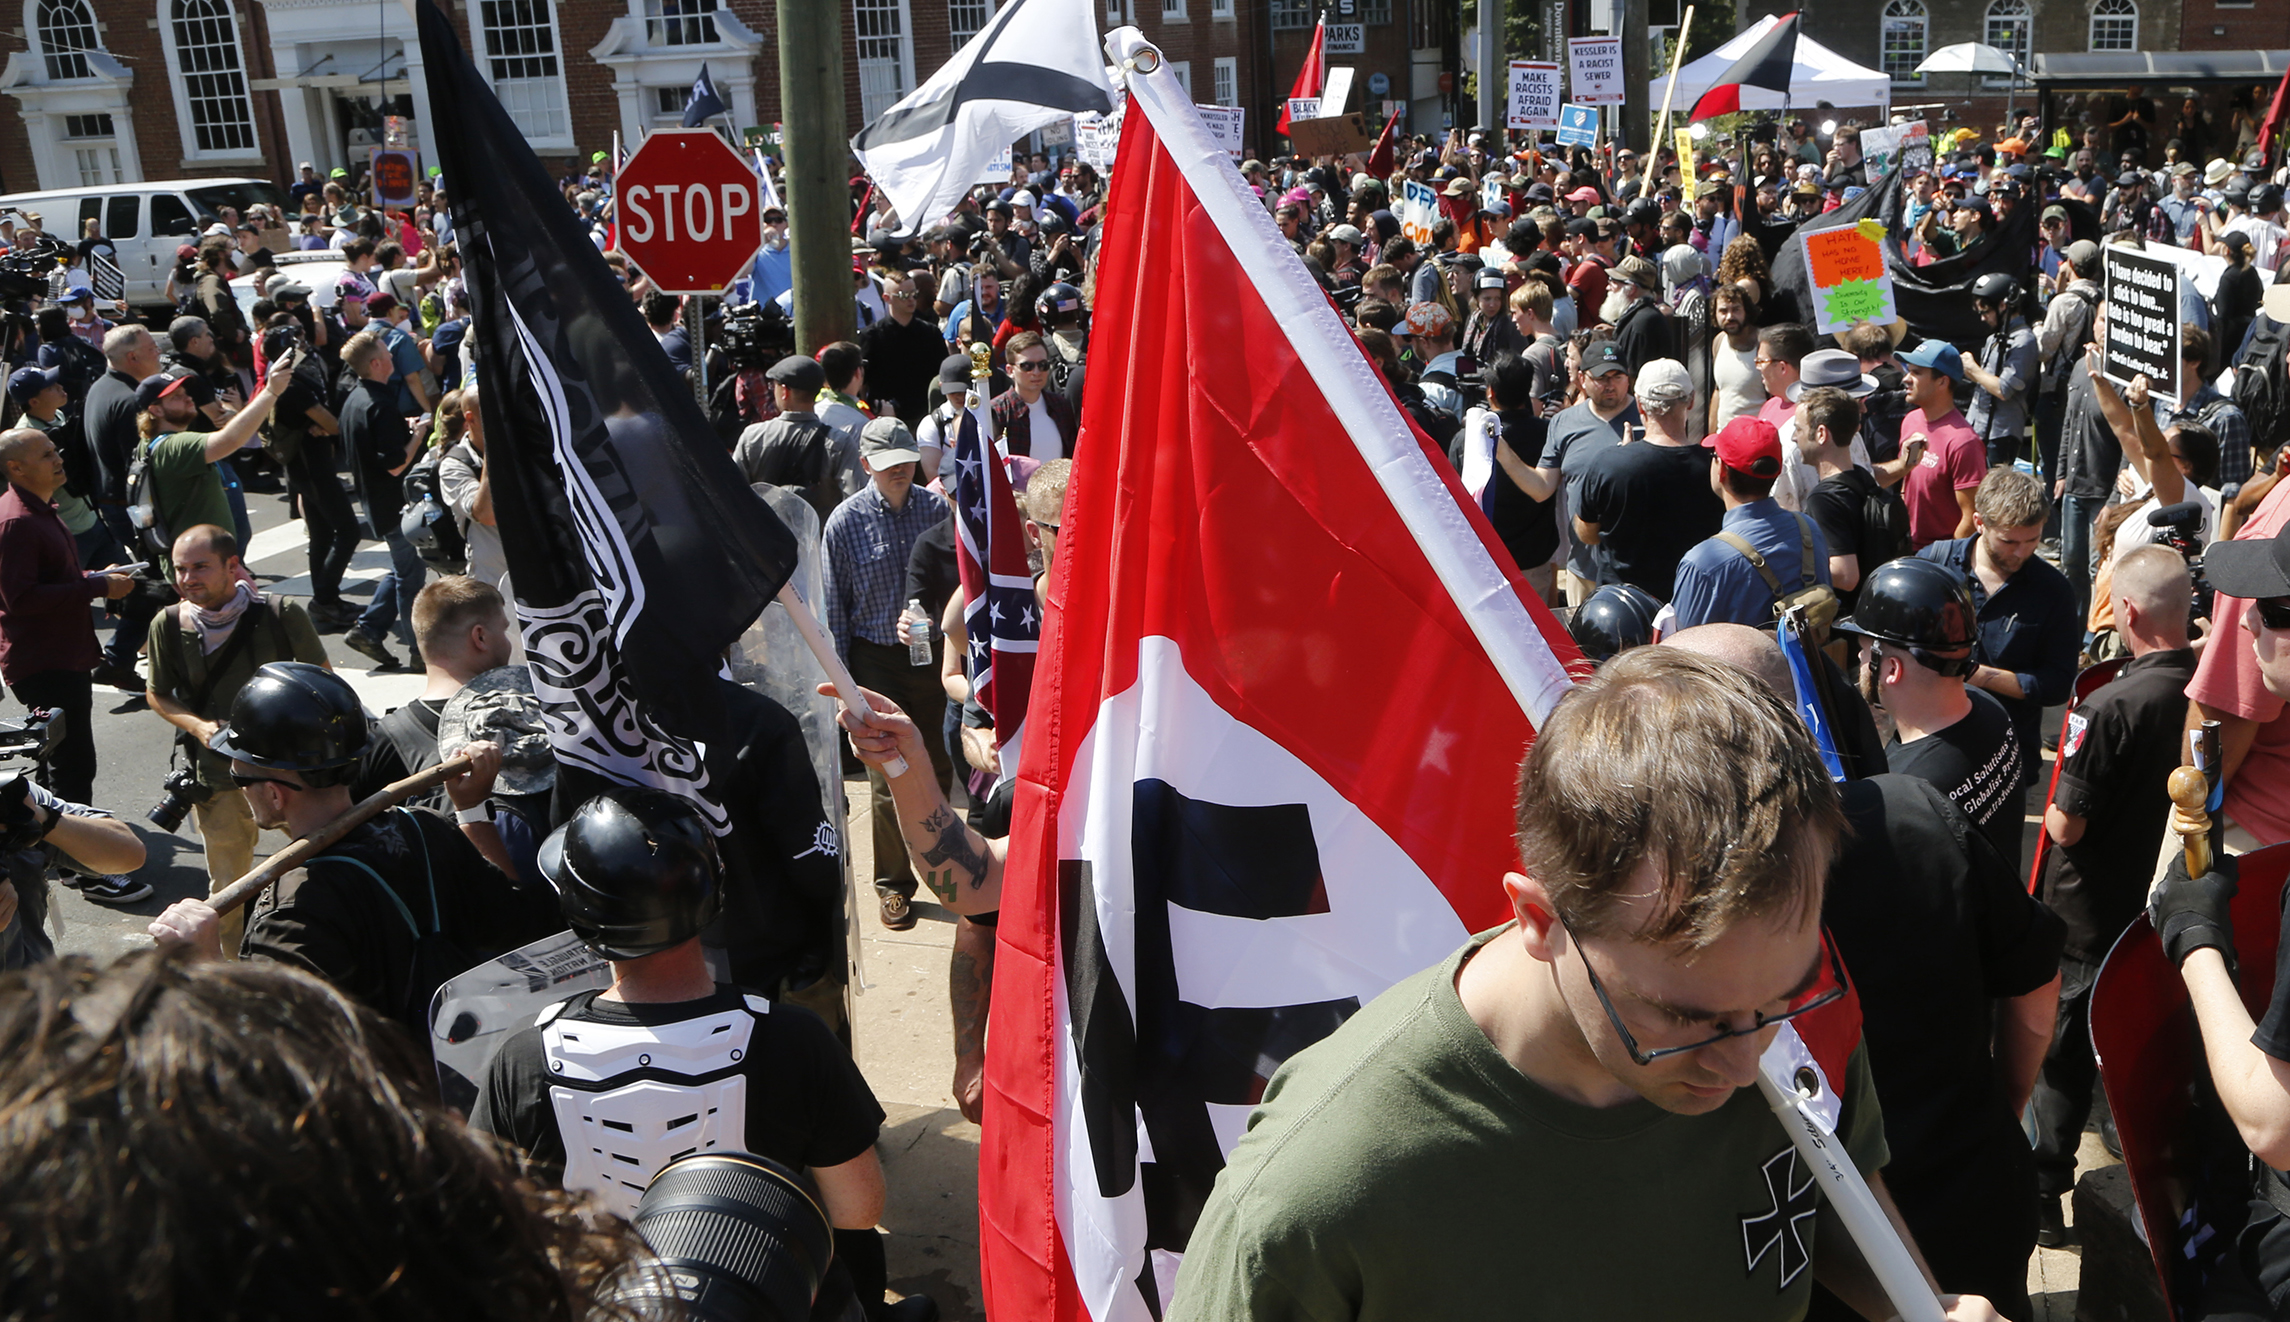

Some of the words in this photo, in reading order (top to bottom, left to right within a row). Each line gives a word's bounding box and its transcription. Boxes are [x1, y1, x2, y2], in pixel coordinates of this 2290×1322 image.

[1554, 2, 1565, 62] Downtown
[1574, 46, 1608, 56] KESSLER
[1609, 45, 1617, 54] IS
[1578, 61, 1585, 69] A
[1587, 58, 1614, 68] RACIST
[1522, 72, 1548, 82] MAKE
[1584, 71, 1611, 81] SEWER
[1515, 83, 1553, 94] RACISTS
[1518, 95, 1552, 106] AFRAID
[1292, 102, 1318, 114] BLACK
[1520, 107, 1549, 116] AGAIN
[1050, 126, 1060, 135] NO
[744, 132, 783, 148] LOVE
[1045, 134, 1068, 144] IDLING
[626, 183, 750, 243] STOP
[1826, 232, 1862, 246] HATE
[1822, 249, 1840, 258] HAS
[1844, 246, 1857, 254] NO
[1834, 256, 1861, 265] HOME
[2116, 262, 2132, 282] have
[2132, 267, 2162, 290] decided
[2162, 273, 2173, 292] to
[1835, 289, 1868, 299] Diversity
[2113, 284, 2130, 302] stick
[2130, 287, 2139, 303] to
[2108, 301, 2122, 321] Hate
[2122, 306, 2130, 324] is
[2130, 310, 2143, 328] too
[2144, 316, 2166, 334] great
[2166, 322, 2174, 337] a
[2110, 323, 2134, 346] burden
[2134, 332, 2143, 349] to
[2127, 356, 2144, 372] Luther
[2144, 362, 2160, 379] King,
[2160, 367, 2169, 380] Jr.
[1948, 778, 1974, 801] ocal
[1974, 740, 2009, 784] Solutions
[1964, 773, 2003, 814] Globalist
